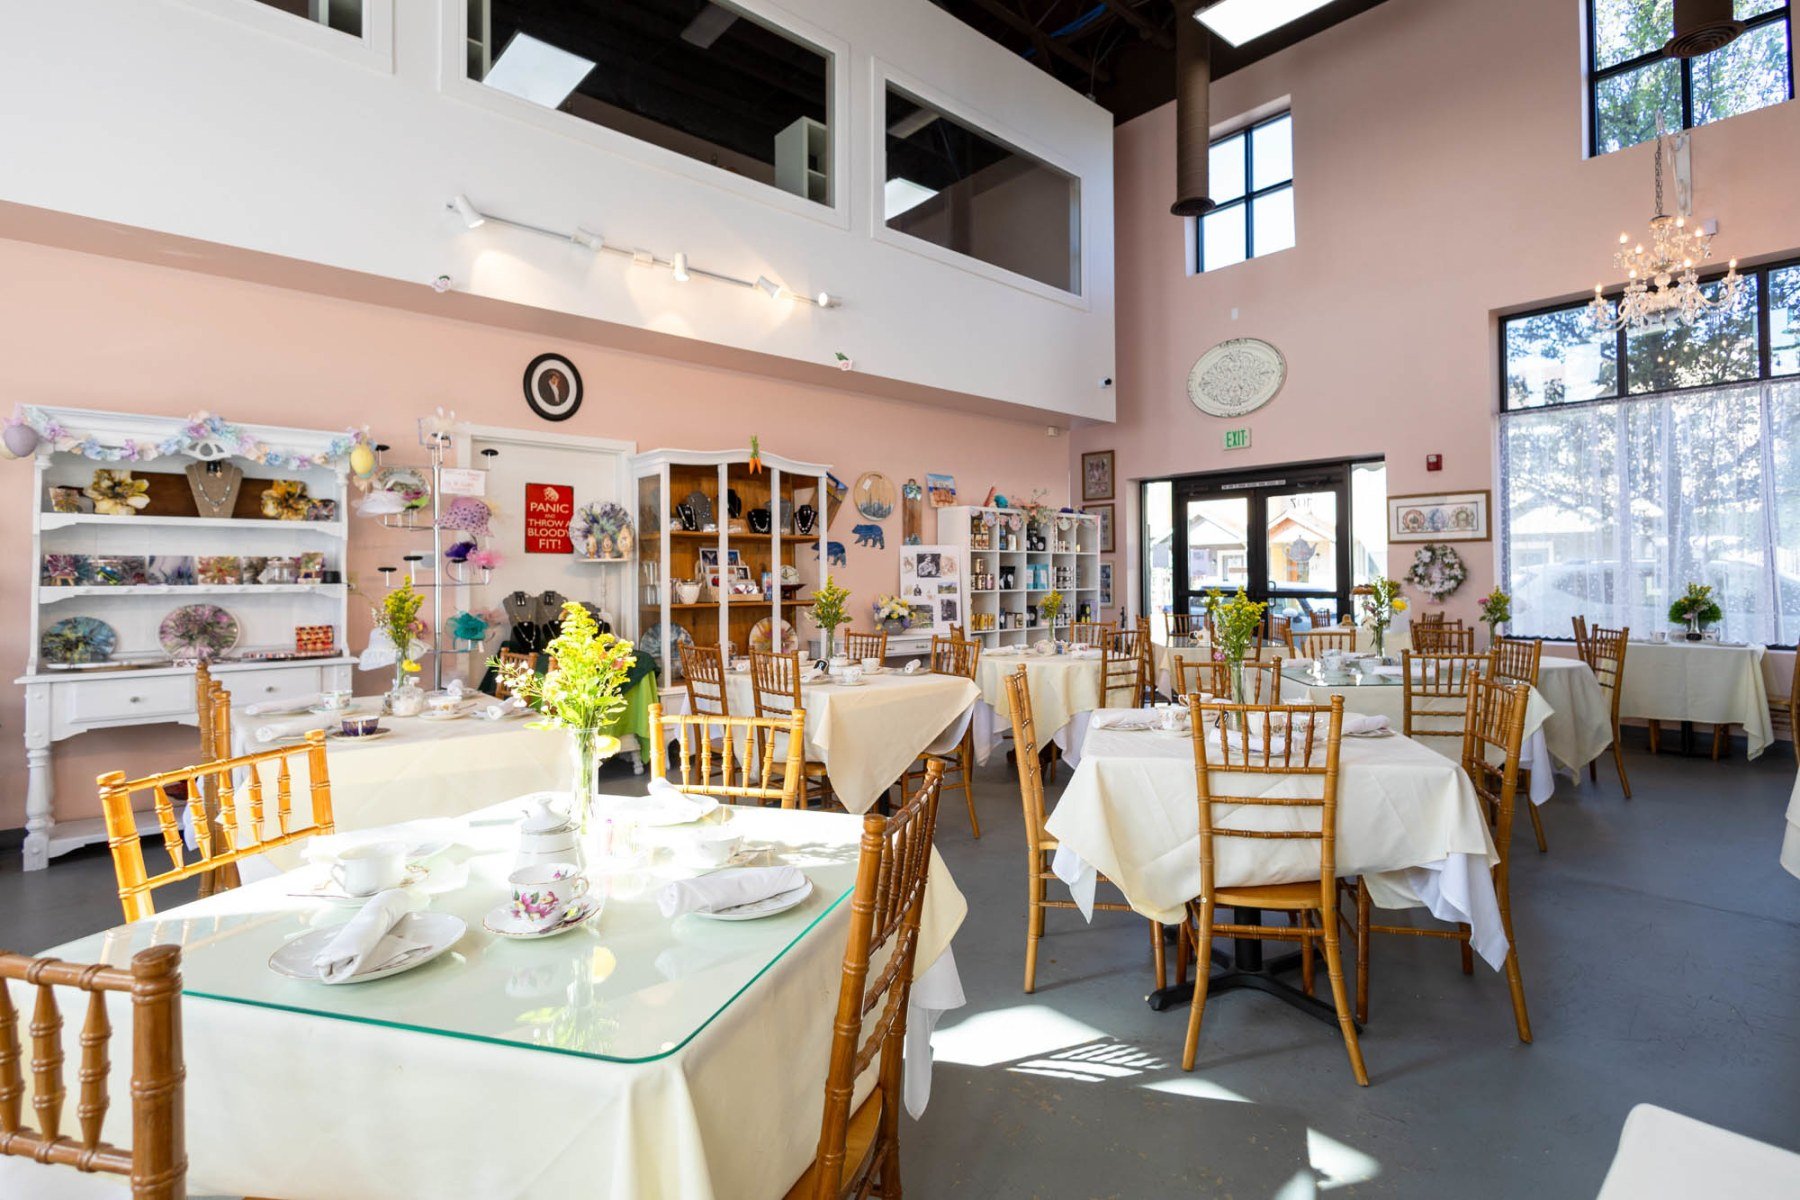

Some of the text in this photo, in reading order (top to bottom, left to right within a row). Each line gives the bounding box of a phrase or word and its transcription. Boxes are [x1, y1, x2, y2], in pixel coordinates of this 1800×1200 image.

[1226, 429, 1246, 448] EXIT
[530, 502, 570, 514] PANIC
[528, 519, 564, 527] THROW
[539, 538, 562, 549] FIT!
